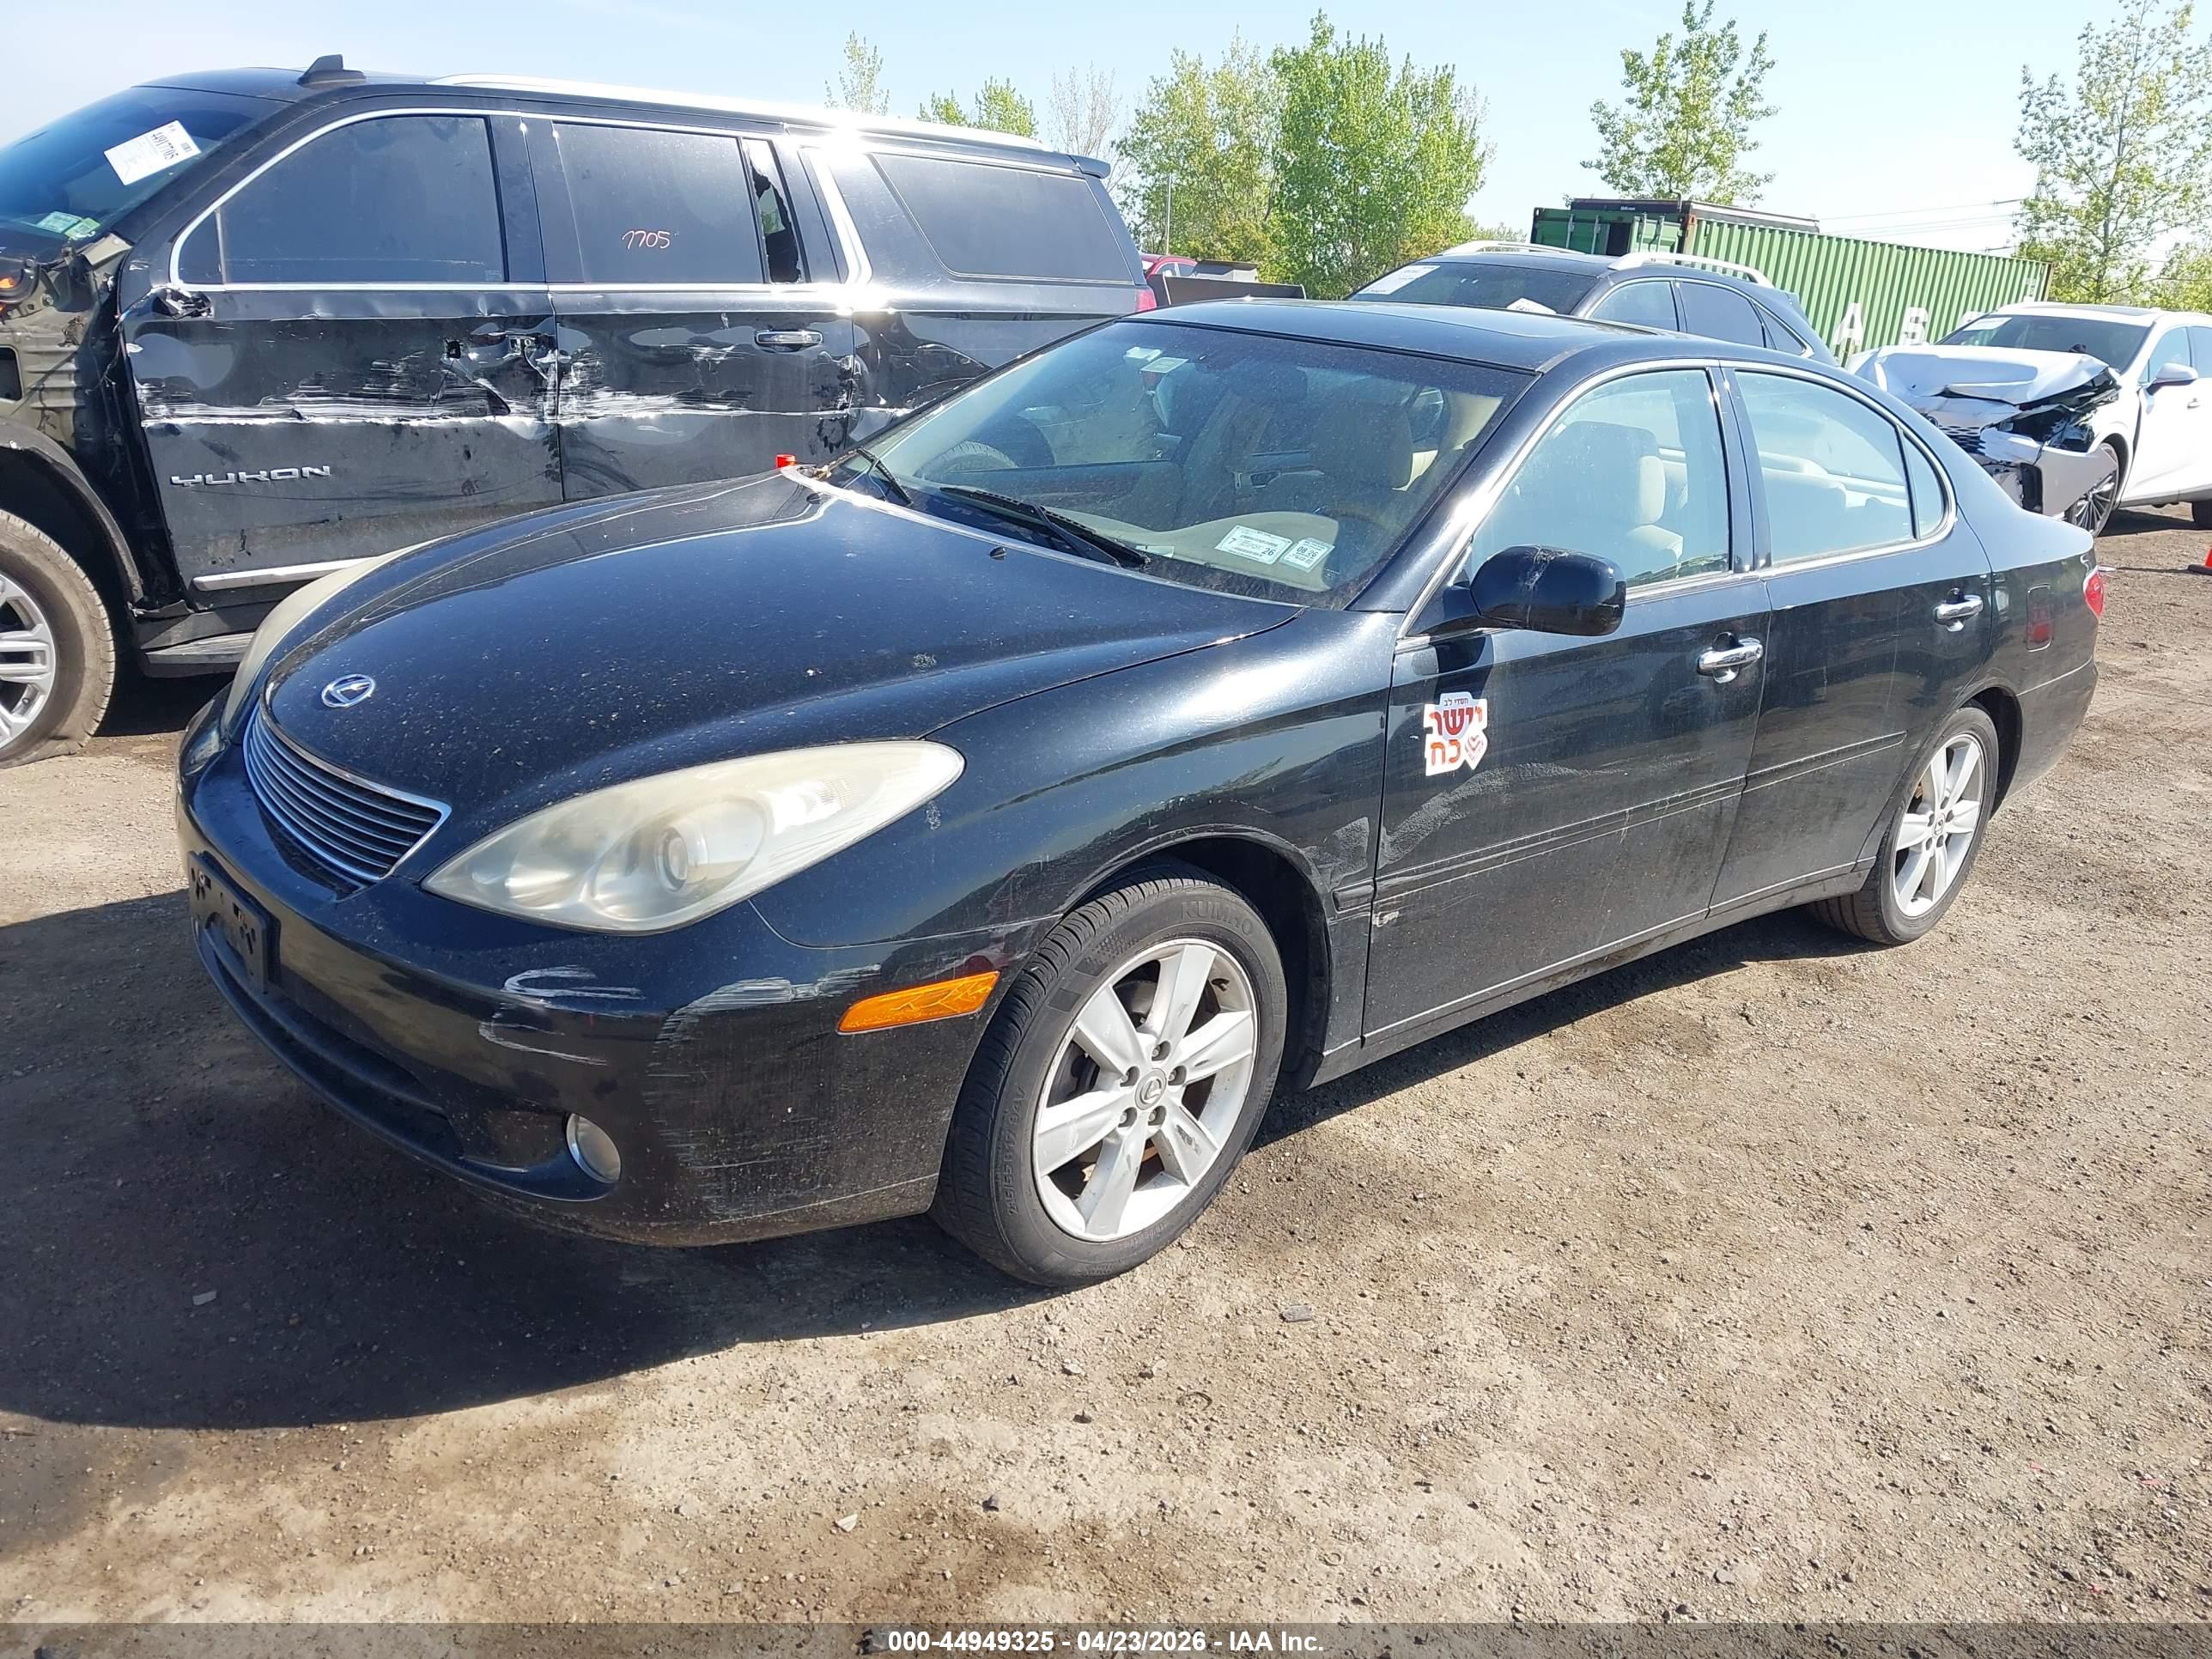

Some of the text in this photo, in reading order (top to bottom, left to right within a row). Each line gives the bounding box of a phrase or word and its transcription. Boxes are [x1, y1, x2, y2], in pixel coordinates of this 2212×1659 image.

[622, 230, 671, 250] 7705
[171, 465, 331, 487] YUKON
[1261, 548, 1276, 556] 26
[1297, 546, 1307, 555] 08
[1443, 697, 1452, 706] לב
[1429, 706, 1483, 736] יישר
[1431, 738, 1461, 766] כח
